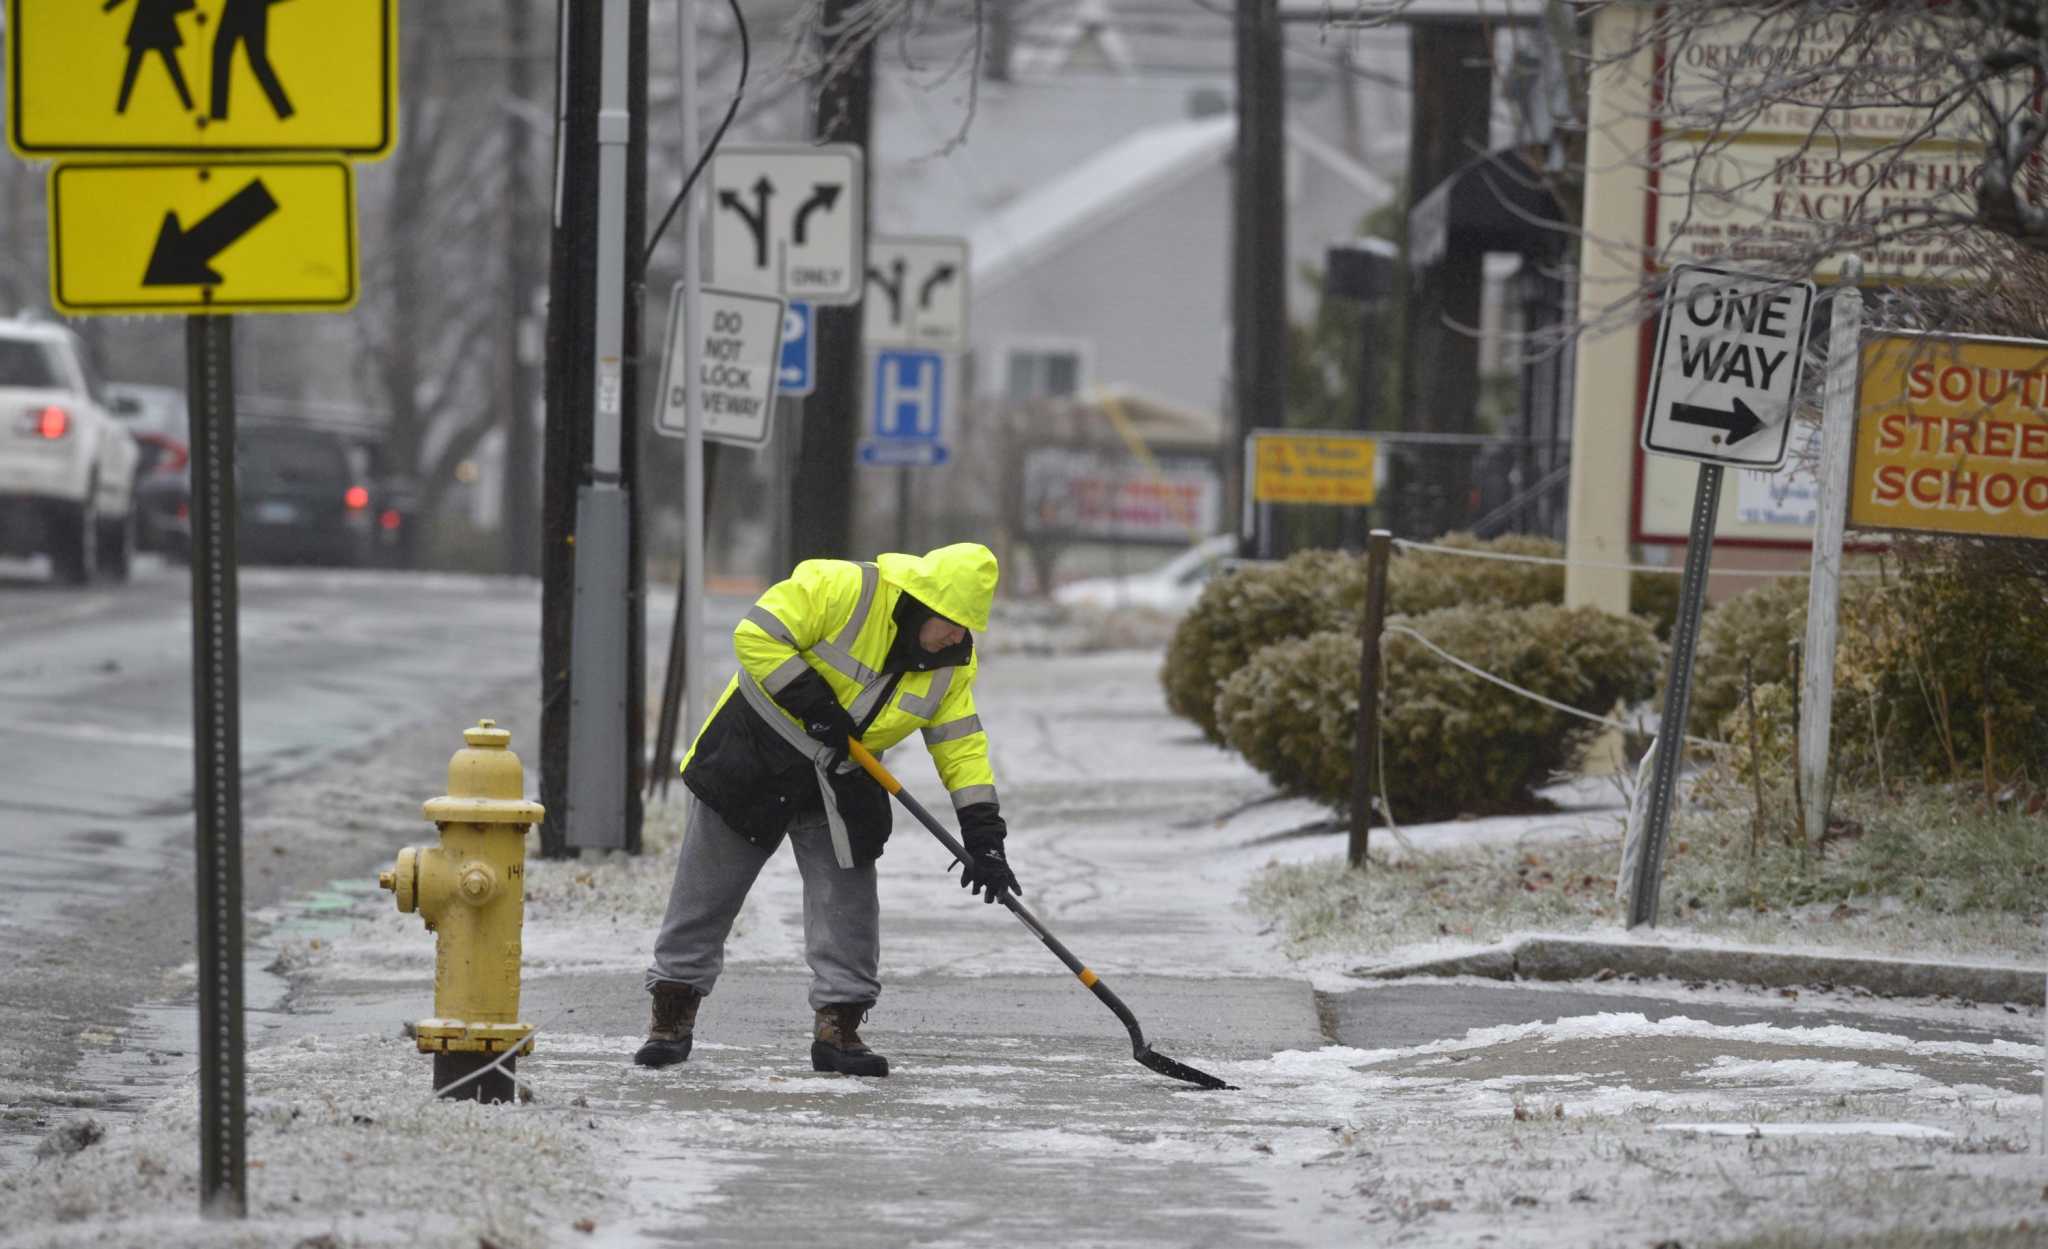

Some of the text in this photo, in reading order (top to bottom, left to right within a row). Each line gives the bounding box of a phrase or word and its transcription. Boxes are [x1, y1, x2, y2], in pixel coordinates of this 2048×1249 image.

[713, 310, 743, 335] DO
[1686, 282, 1792, 339] ONE
[704, 336, 744, 361] NOT
[1679, 334, 1789, 392] WAY
[669, 384, 763, 418] DVEWAY
[700, 364, 752, 391] LOCK
[883, 360, 933, 432] H
[1906, 362, 2048, 411] SOUT
[1874, 413, 2048, 463] STREE
[1872, 464, 2048, 515] SCHOO
